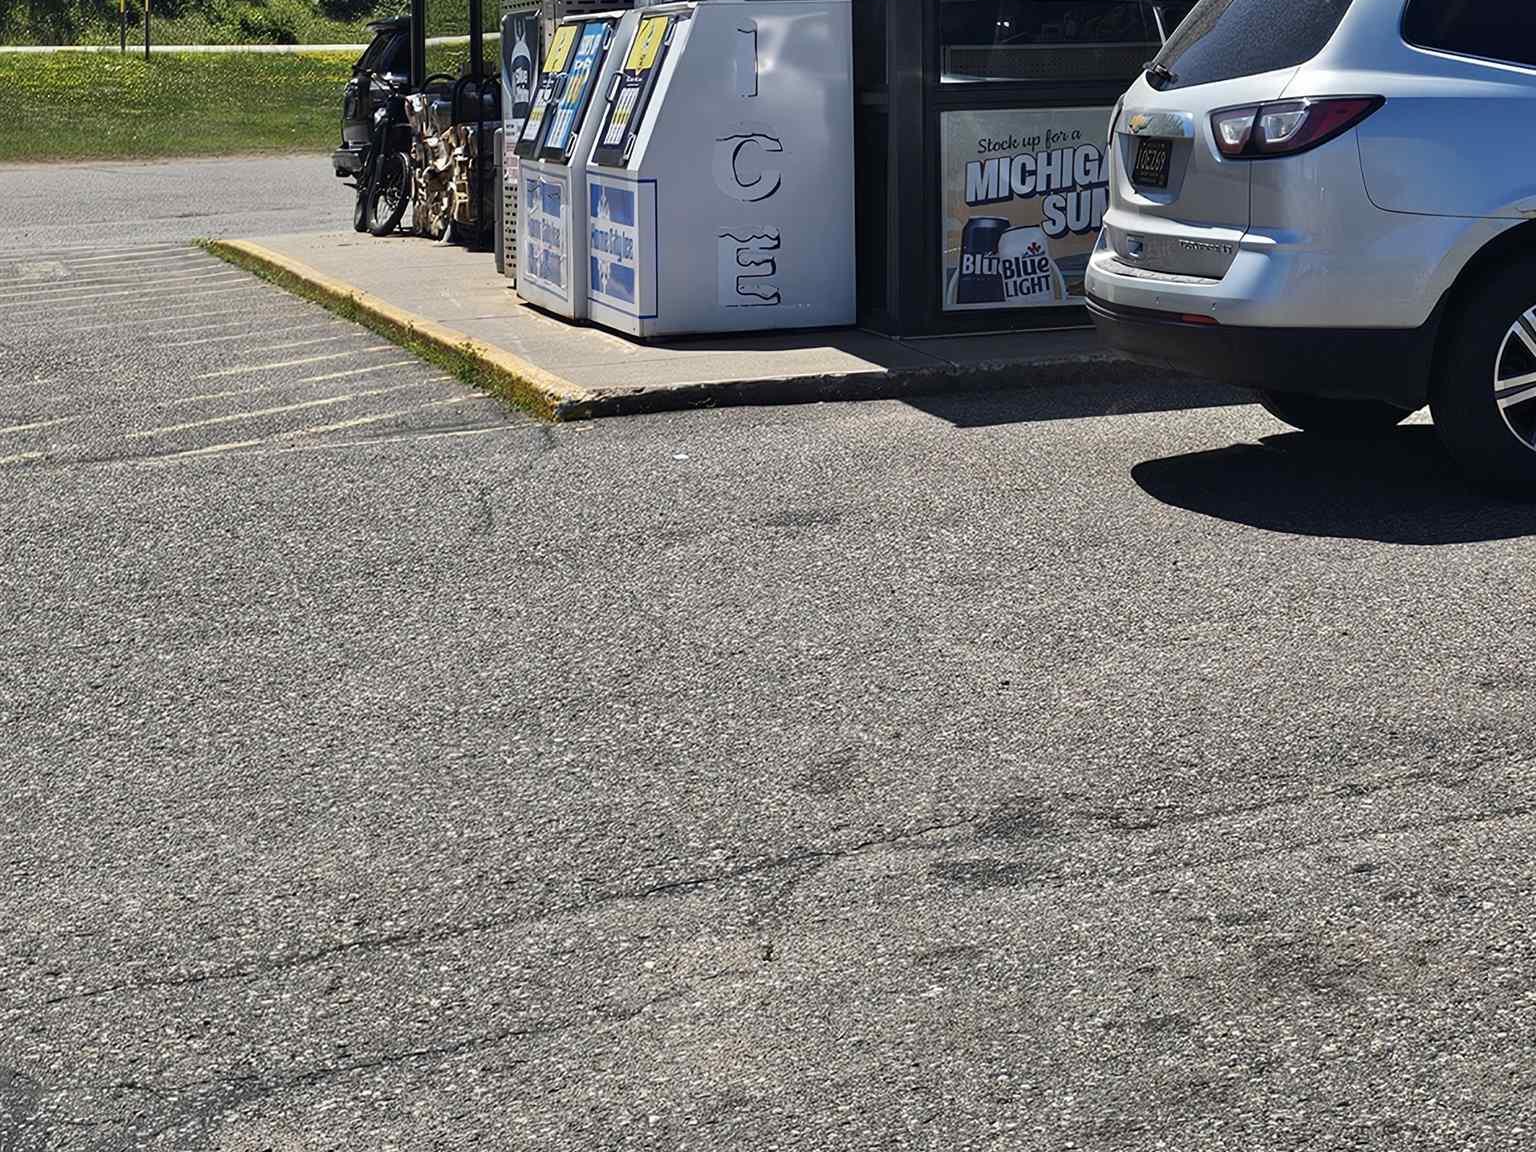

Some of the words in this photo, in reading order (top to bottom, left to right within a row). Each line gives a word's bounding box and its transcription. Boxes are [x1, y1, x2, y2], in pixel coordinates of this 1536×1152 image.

[977, 135, 1019, 154] Stock
[1022, 136, 1041, 151] up
[1045, 128, 1070, 149] for
[1072, 129, 1083, 141] a
[711, 18, 783, 308] ICE
[962, 251, 999, 276] Blu
[1002, 255, 1050, 281] Blue
[1004, 274, 1051, 298] LIGHT
